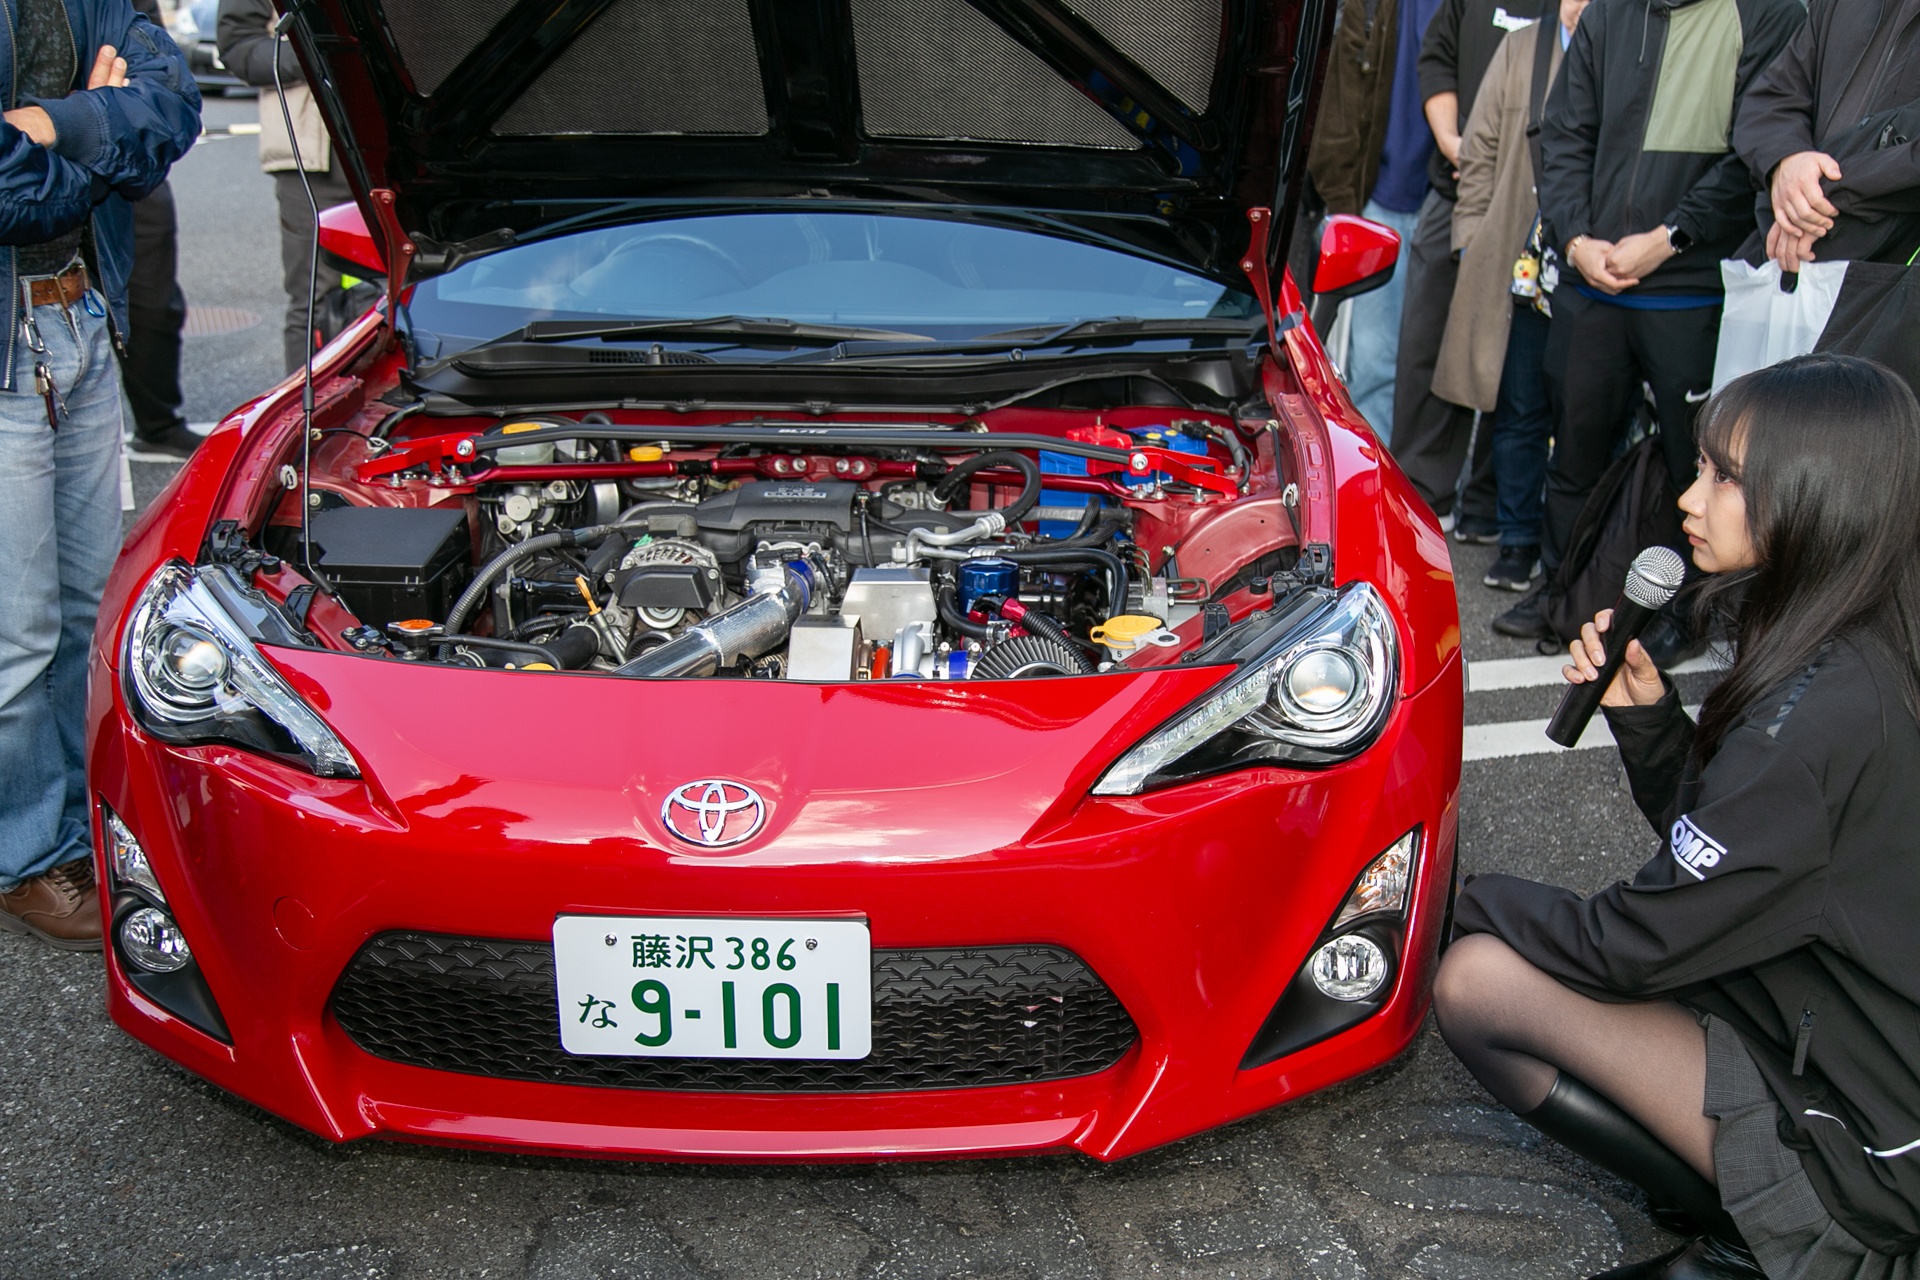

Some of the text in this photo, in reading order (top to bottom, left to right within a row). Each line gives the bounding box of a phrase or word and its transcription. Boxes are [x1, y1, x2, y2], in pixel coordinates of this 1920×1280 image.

[1671, 820, 1720, 868] OMP
[630, 934, 797, 971] 藤沢 386
[577, 979, 840, 1050] な 9-101
